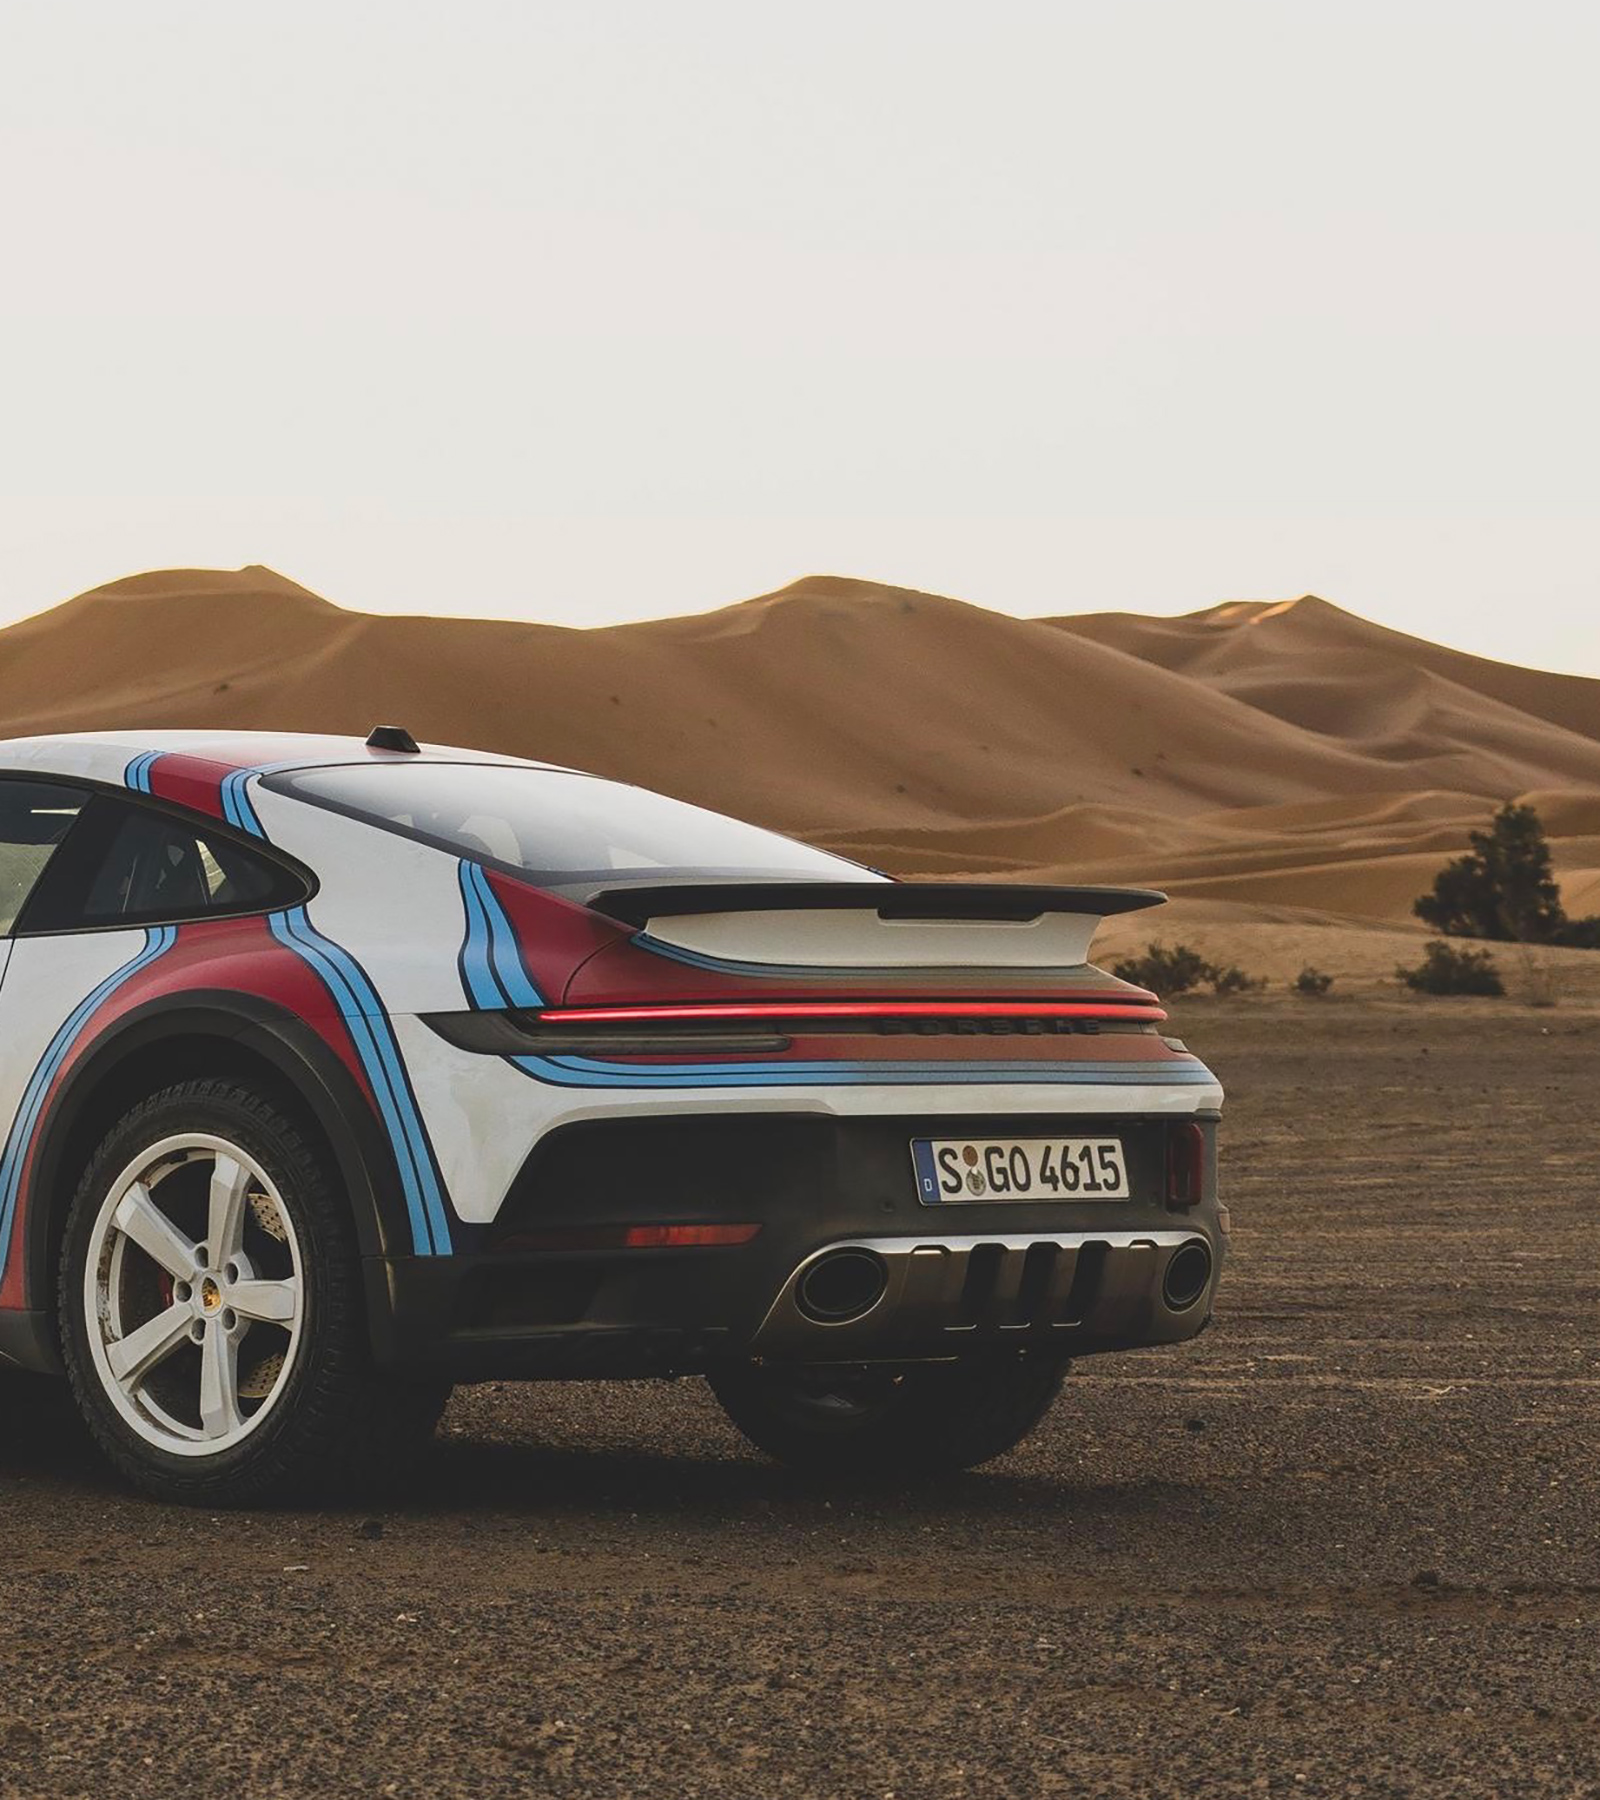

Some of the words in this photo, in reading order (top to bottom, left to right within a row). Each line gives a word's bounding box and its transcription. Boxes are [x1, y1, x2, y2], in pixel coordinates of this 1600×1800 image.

[938, 1148, 963, 1193] S
[984, 1145, 1032, 1192] GO
[1039, 1145, 1121, 1192] 4615
[924, 1178, 933, 1192] D
